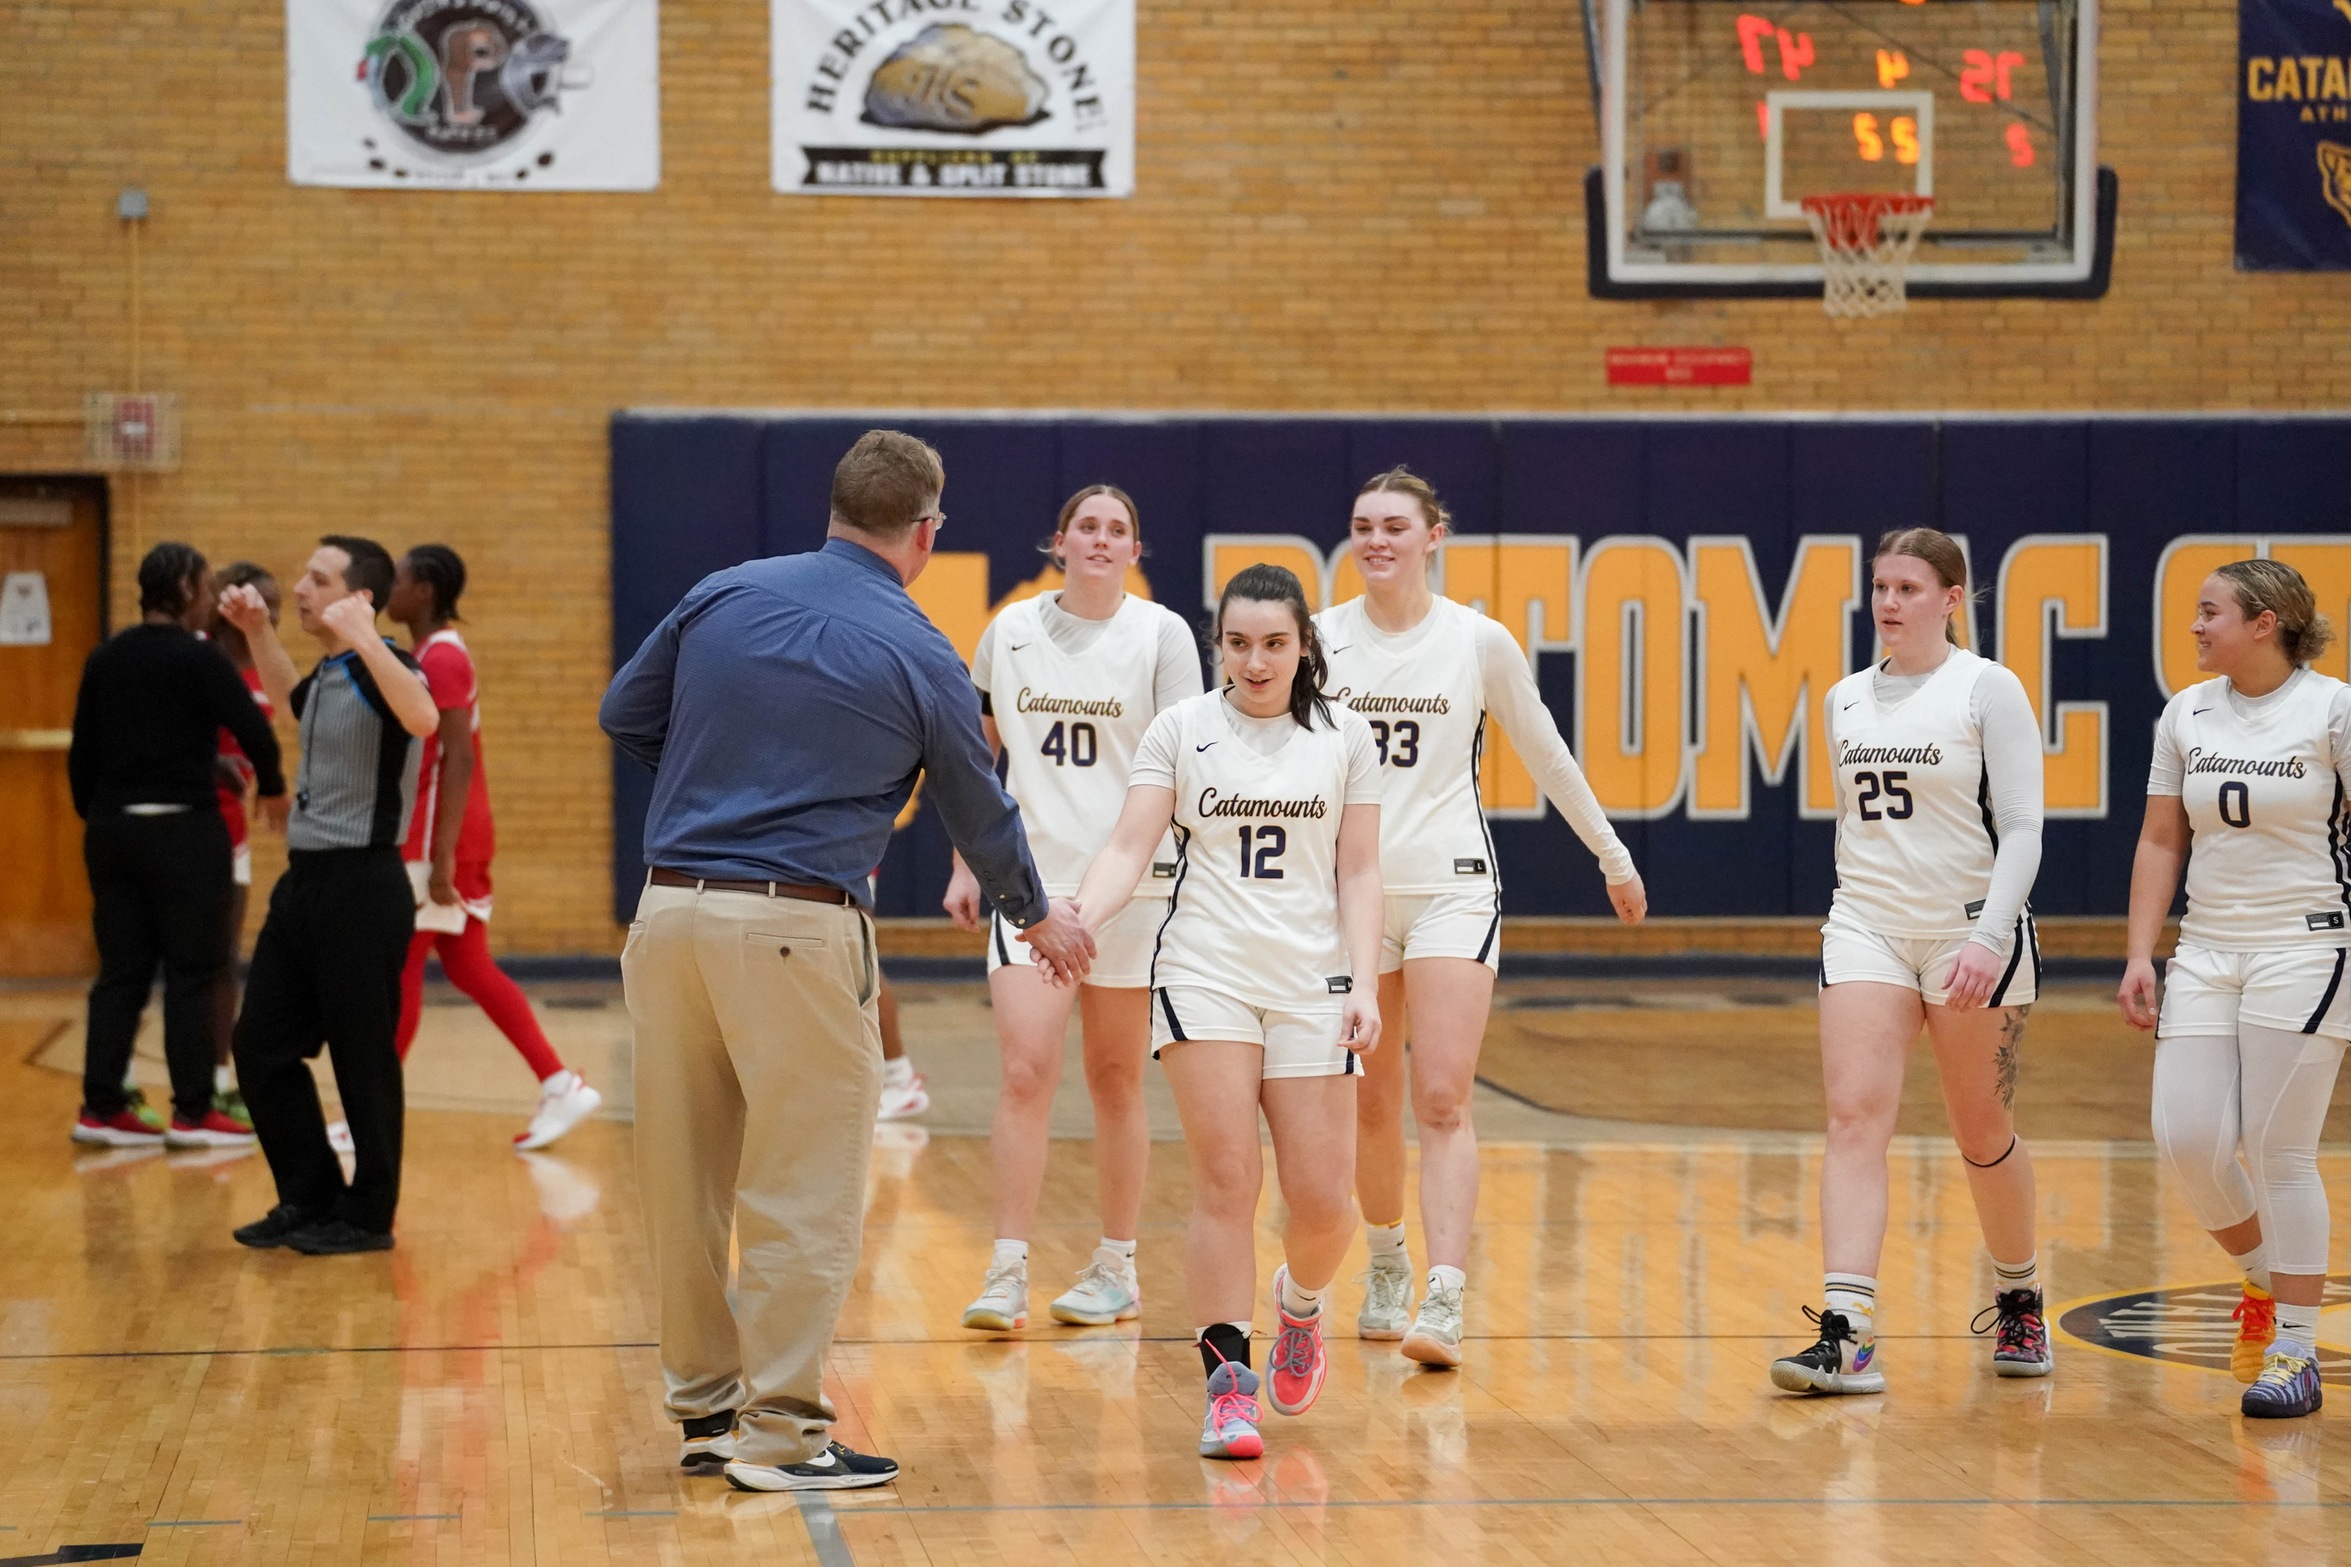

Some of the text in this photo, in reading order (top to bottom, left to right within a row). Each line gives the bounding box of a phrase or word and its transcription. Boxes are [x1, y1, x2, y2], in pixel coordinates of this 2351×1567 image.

[1003, 0, 1106, 131] STONE
[1016, 686, 1123, 719] Catamounts
[1040, 720, 1098, 768] 40
[1838, 739, 1944, 768] Catamounts
[2186, 746, 2308, 780] Catamounts
[1198, 786, 1328, 821] Catamounts
[1854, 770, 1914, 822] 25
[2218, 780, 2252, 829] 0
[1238, 824, 1287, 880] 12
